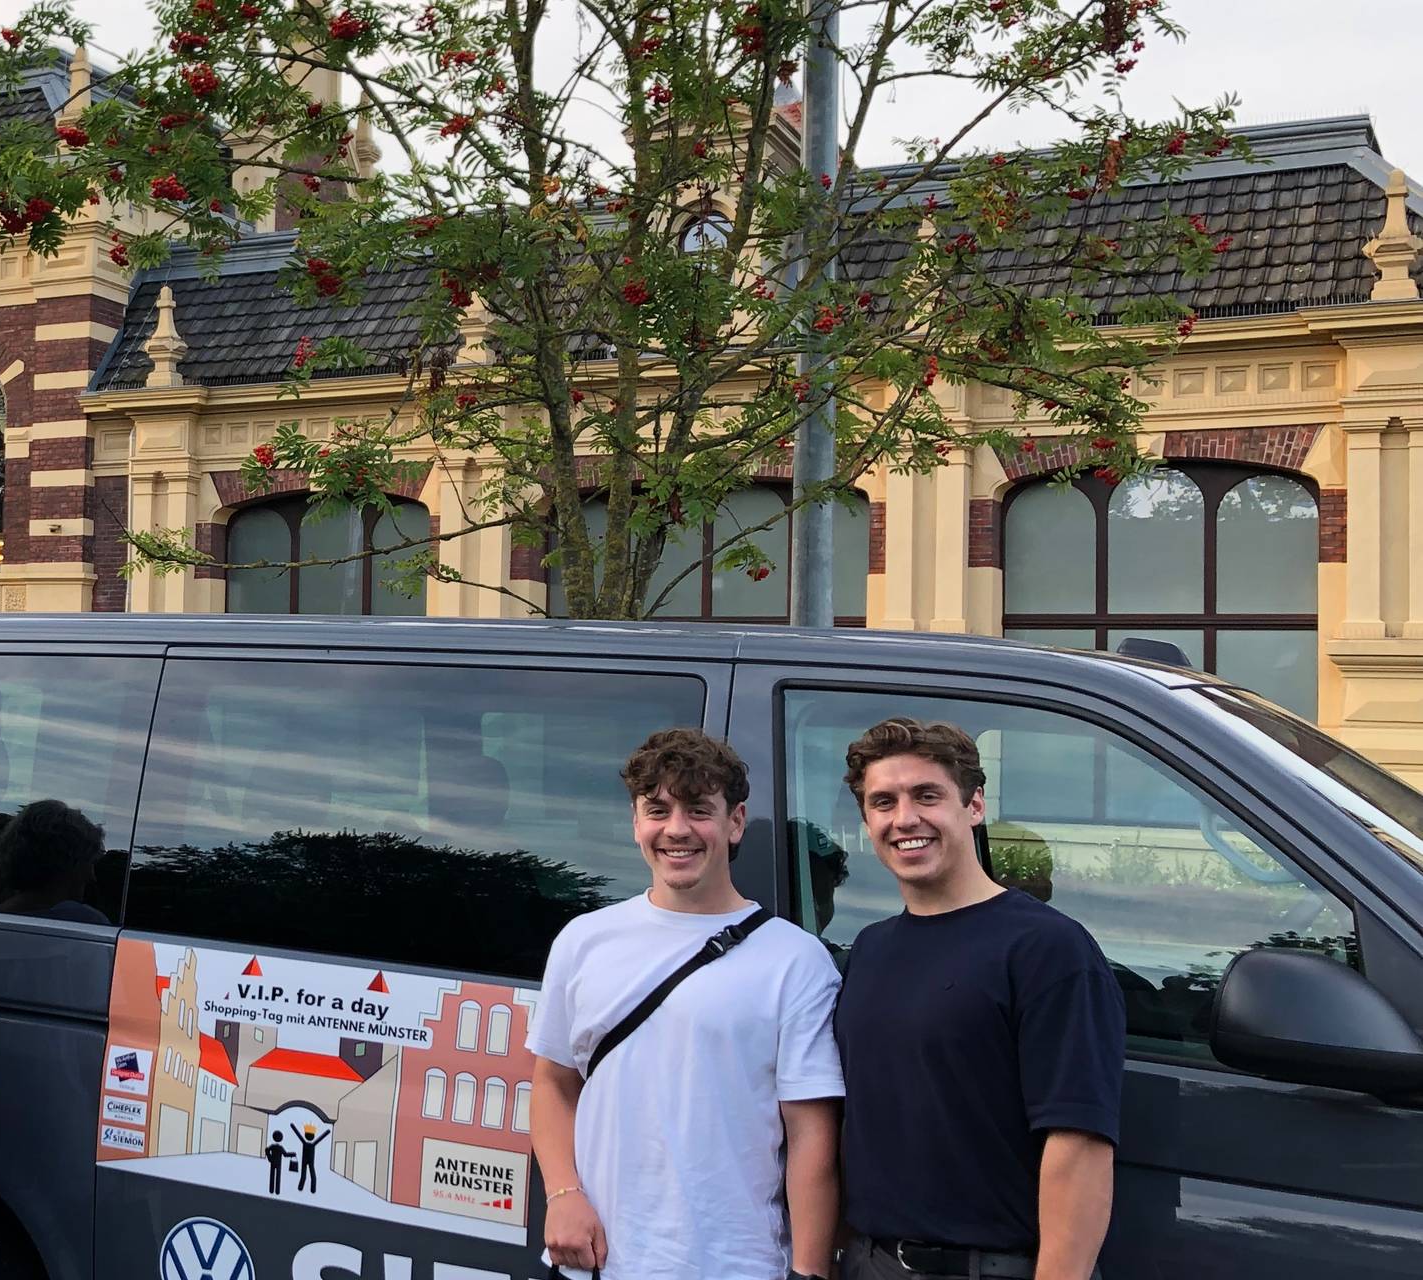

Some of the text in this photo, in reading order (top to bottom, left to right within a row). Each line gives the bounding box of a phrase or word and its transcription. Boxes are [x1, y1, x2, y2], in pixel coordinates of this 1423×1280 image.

[237, 983, 390, 1021] V.I.P. for a day
[204, 1000, 428, 1042] Shopping-Tag mit ANTENNE MÜNSTER
[107, 1101, 142, 1115] CINEPLEX
[112, 1134, 144, 1147] SIEMON
[435, 1156, 514, 1181] ANTENNE
[433, 1170, 513, 1196] MÜNSTER
